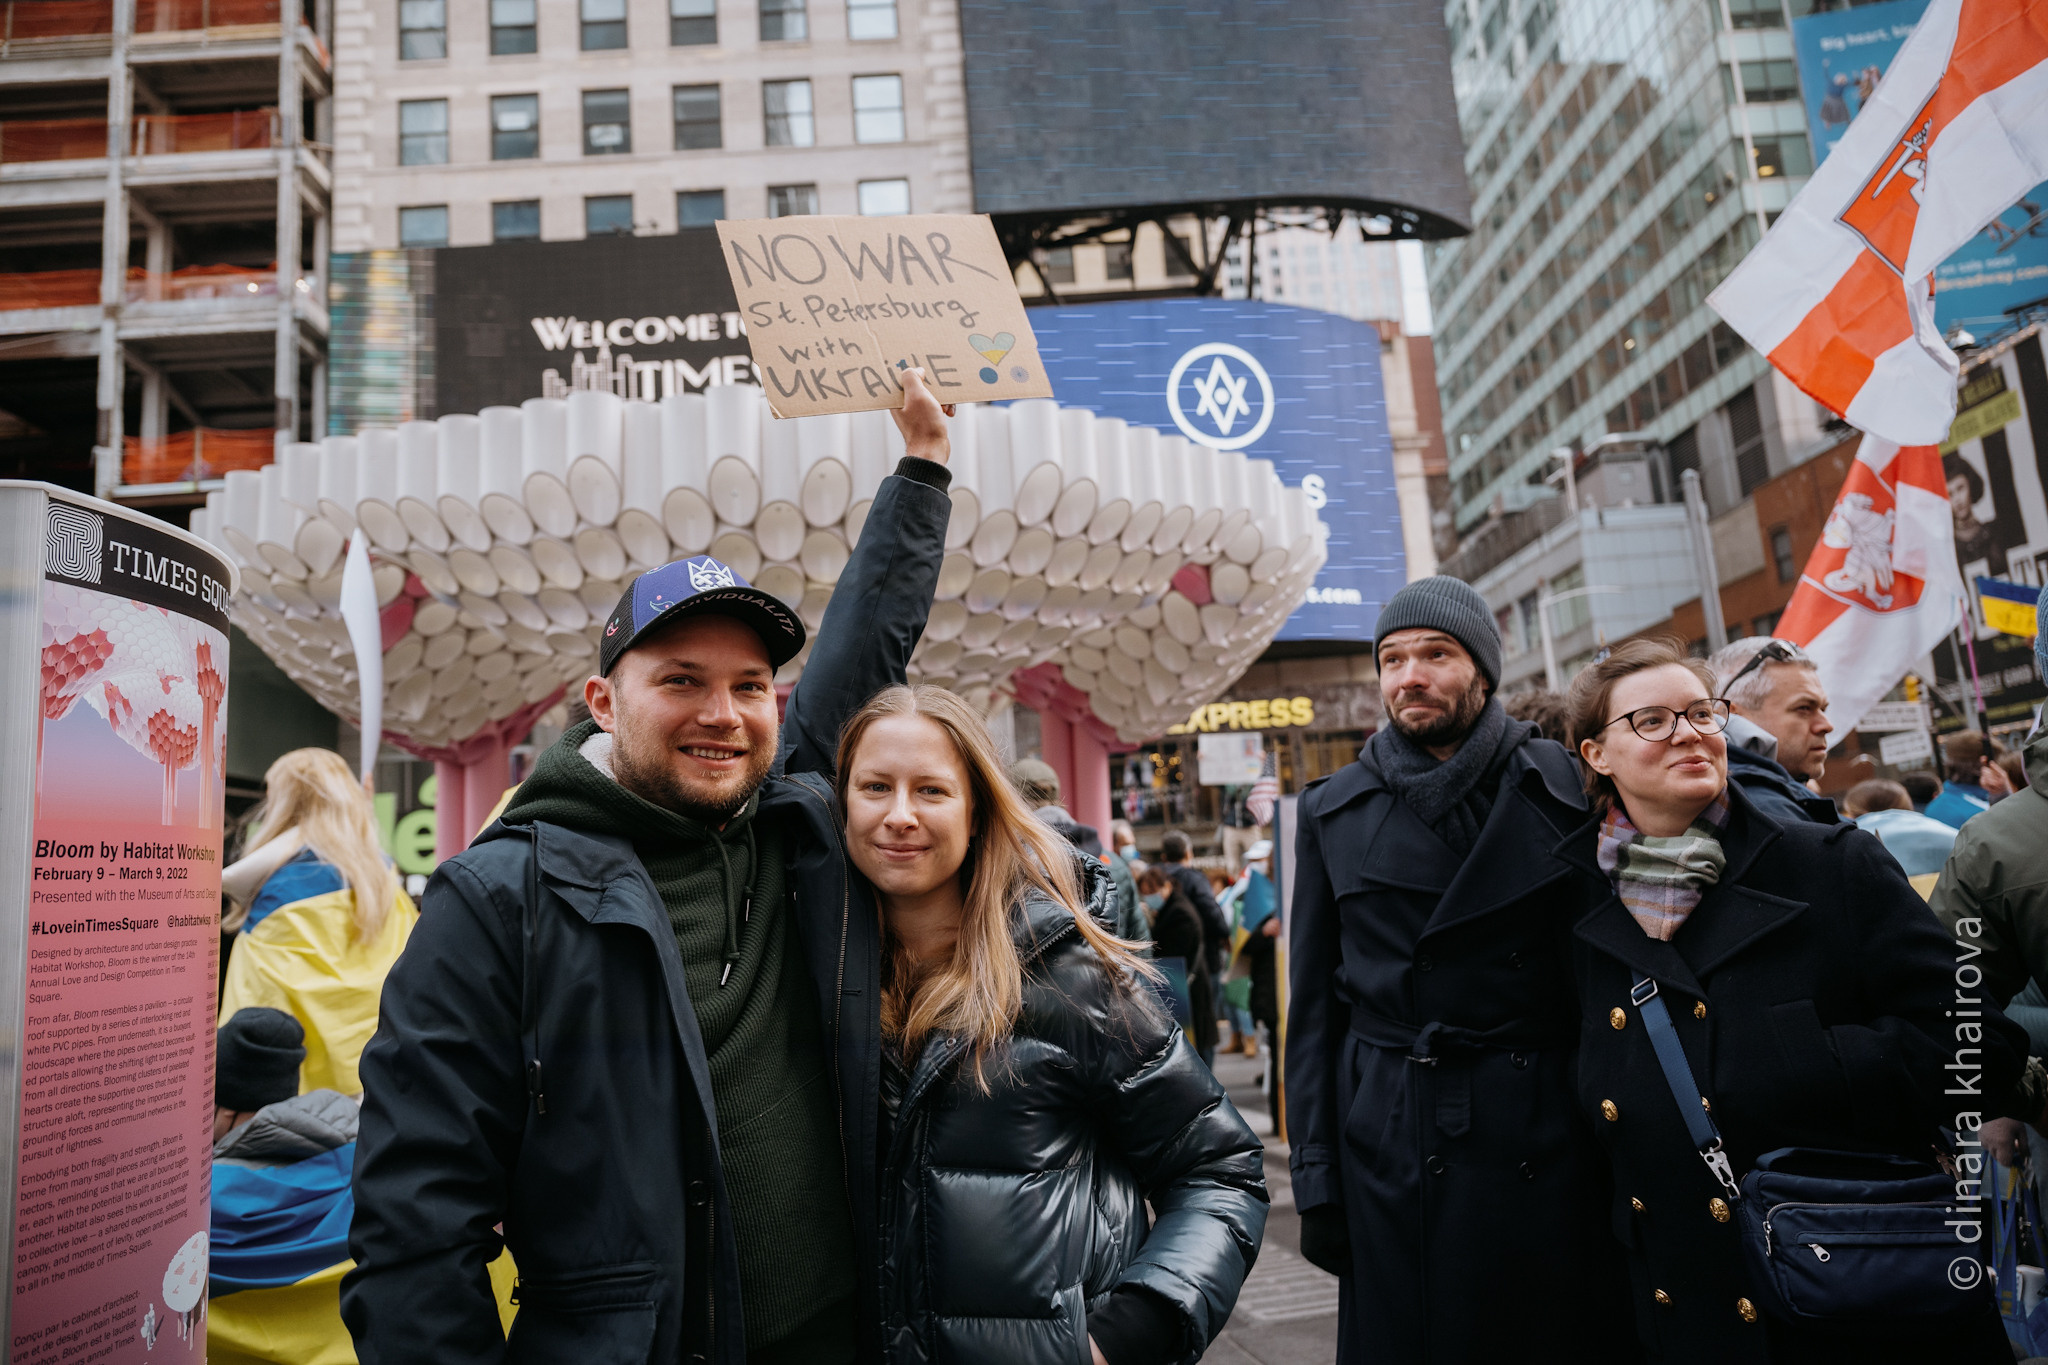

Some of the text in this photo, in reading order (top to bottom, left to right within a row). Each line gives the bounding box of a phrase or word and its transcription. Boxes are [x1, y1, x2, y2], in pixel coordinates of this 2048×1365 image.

[729, 232, 999, 289] NO WAR
[720, 311, 748, 340] T
[778, 336, 863, 364] with
[632, 354, 764, 402] TIME
[109, 540, 197, 596] TIMES
[202, 574, 231, 621] SQUA
[1167, 696, 1315, 736] XPRESS
[35, 840, 95, 858] Bloom
[100, 841, 119, 862] by
[123, 841, 174, 860] Habitat
[34, 868, 93, 882] February
[97, 868, 105, 879] 9
[119, 867, 153, 879] March
[156, 867, 165, 881] 9,
[167, 867, 188, 879] 2022
[33, 890, 92, 903] Presented
[95, 890, 118, 902] with
[119, 890, 135, 901] the
[138, 889, 173, 901] Museum
[175, 889, 182, 900] of
[32, 918, 159, 935] #LoveinTimesSquare
[31, 948, 72, 960] Designed
[73, 947, 83, 958] by
[85, 945, 129, 955] architecture
[31, 963, 63, 974] Habitat
[65, 960, 106, 971] Workshop,
[30, 977, 60, 988] Annual
[62, 976, 82, 985] Love
[84, 973, 99, 983] and
[29, 994, 63, 1005] Square.
[28, 1016, 50, 1026] From
[52, 1014, 72, 1023] afar,
[74, 1011, 99, 1021] Bloom
[27, 1030, 45, 1041] roof
[47, 1024, 90, 1039] supported
[91, 1023, 101, 1033] by
[27, 1045, 51, 1056] white
[52, 1041, 70, 1052] PVC
[72, 1039, 96, 1051] pipes.
[98, 1036, 116, 1045] From
[26, 1056, 75, 1071] cloudscape
[77, 1052, 102, 1063] where
[103, 1048, 116, 1058] the
[25, 1076, 37, 1087] ed
[39, 1072, 70, 1087] portals
[71, 1066, 104, 1079] allowing
[25, 1091, 46, 1101] from
[48, 1087, 58, 1097] all
[60, 1081, 102, 1095] directions.
[24, 1105, 53, 1117] hearts
[55, 1100, 81, 1111] create
[83, 1096, 96, 1106] the
[23, 1117, 63, 1131] structure
[65, 1112, 86, 1123] aloft,
[22, 1131, 67, 1148] grounding
[68, 1126, 93, 1137] forces
[95, 1120, 110, 1132] and
[22, 1138, 104, 1164] pursuit of lightness.
[22, 1168, 70, 1185] Embodying
[71, 1161, 89, 1174] both
[91, 1155, 118, 1169] fragility
[20, 1187, 47, 1200] borne
[49, 1182, 69, 1193] from
[71, 1175, 92, 1188] many
[94, 1167, 115, 1181] small
[19, 1193, 124, 1232] er, each with the potential
[20, 1201, 56, 1216] nectors,
[58, 1188, 99, 1206] reminding
[18, 1232, 55, 1248] another.
[58, 1220, 88, 1237] Habitat
[89, 1215, 105, 1227] also
[17, 1238, 114, 1278] canopy, and moment of
[18, 1235, 88, 1263] to collective love
[16, 1285, 26, 1294] to
[28, 1278, 38, 1290] all
[41, 1276, 49, 1286] in
[51, 1271, 66, 1282] the
[68, 1260, 95, 1276] middle
[97, 1255, 105, 1266] of
